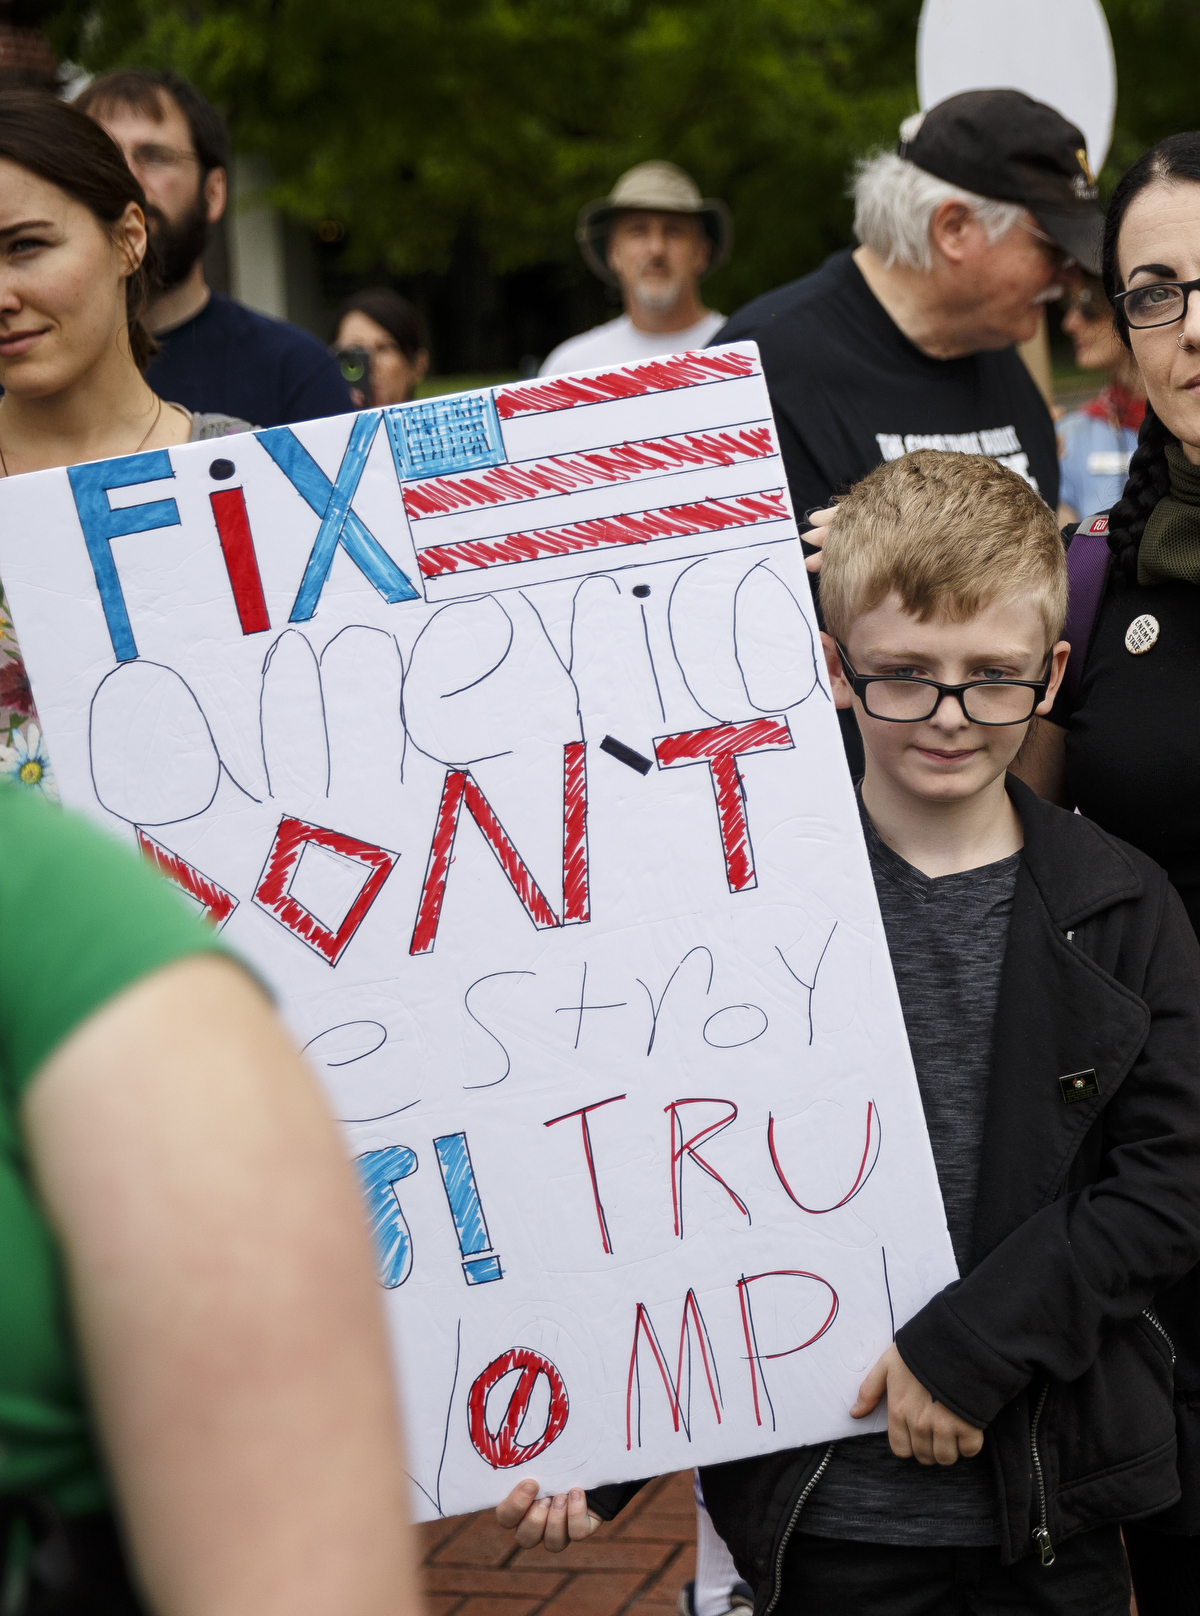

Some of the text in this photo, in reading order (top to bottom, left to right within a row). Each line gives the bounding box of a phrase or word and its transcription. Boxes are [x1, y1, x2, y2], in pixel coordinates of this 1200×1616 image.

[1135, 619, 1153, 642] ENEMY
[1127, 634, 1140, 652] STATE
[544, 1093, 882, 1256] TRU
